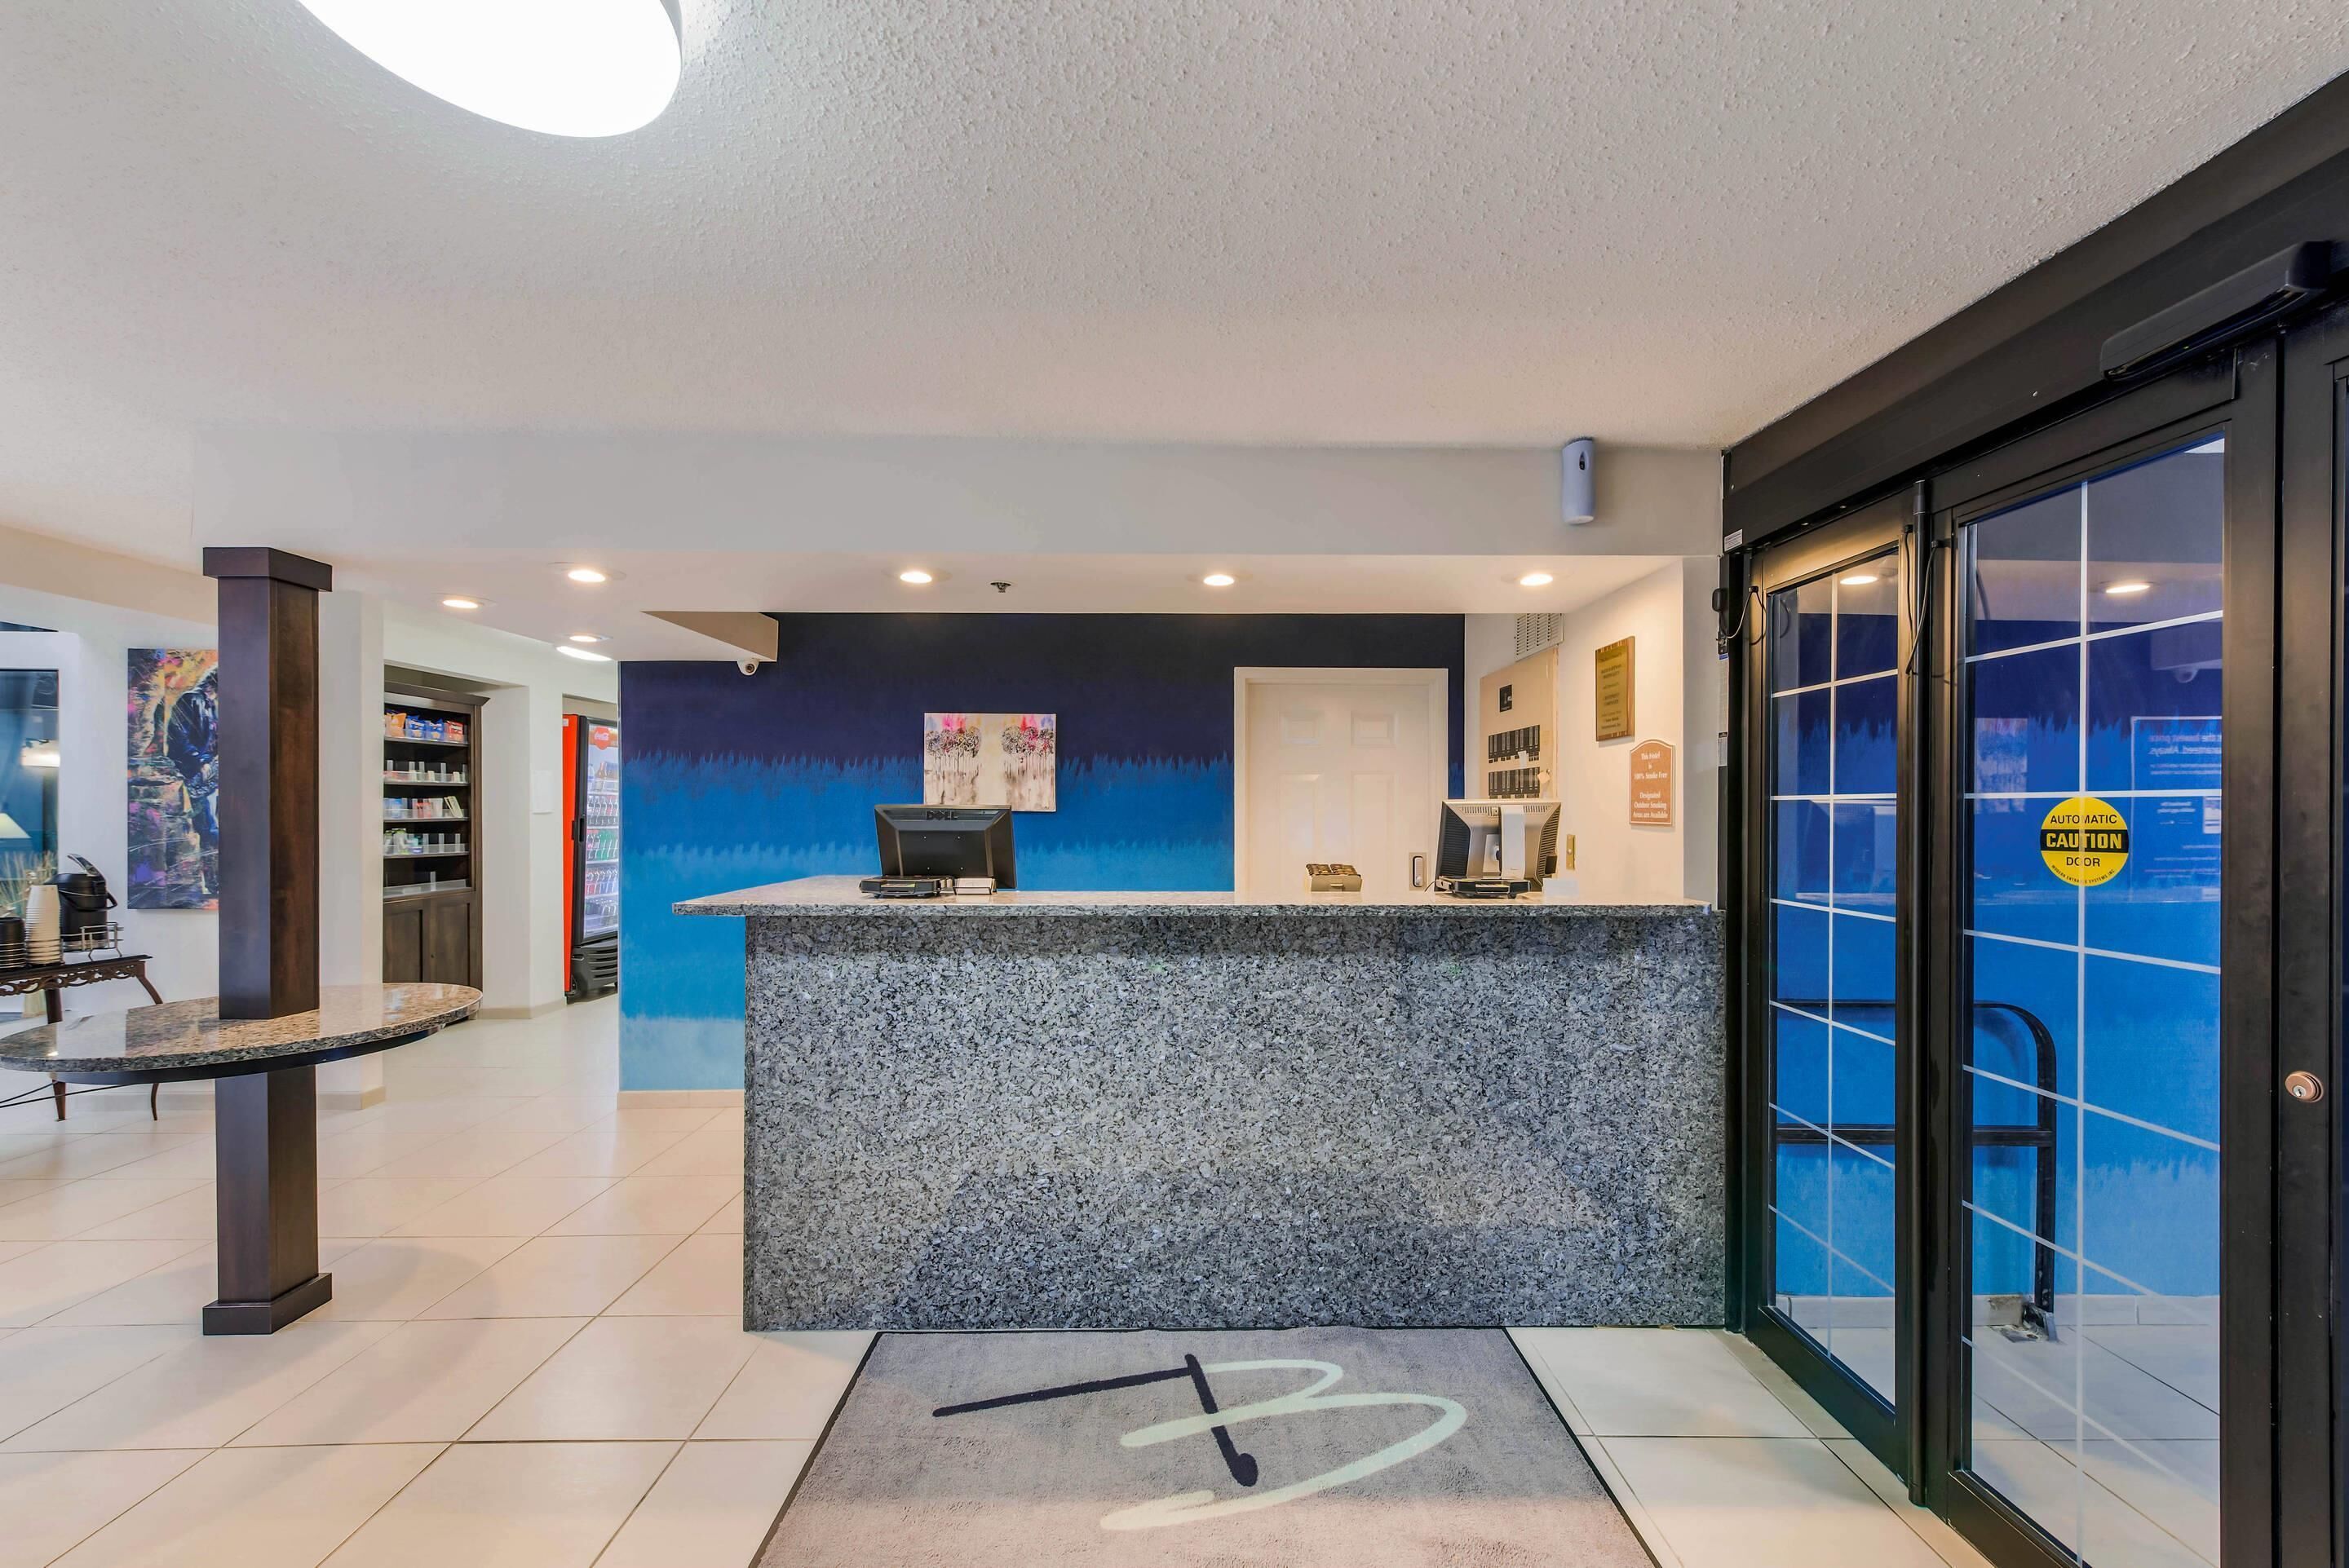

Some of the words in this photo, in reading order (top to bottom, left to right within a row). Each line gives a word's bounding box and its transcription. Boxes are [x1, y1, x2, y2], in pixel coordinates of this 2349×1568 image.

[1645, 771, 1658, 780] Smoke
[1639, 791, 1661, 800] Designated
[1650, 801, 1667, 810] Smoking
[926, 810, 958, 820] DELL
[2050, 815, 2117, 824] AUTOMATIC
[2046, 833, 2122, 849] CAUTION
[2066, 856, 2100, 867] DOOR
